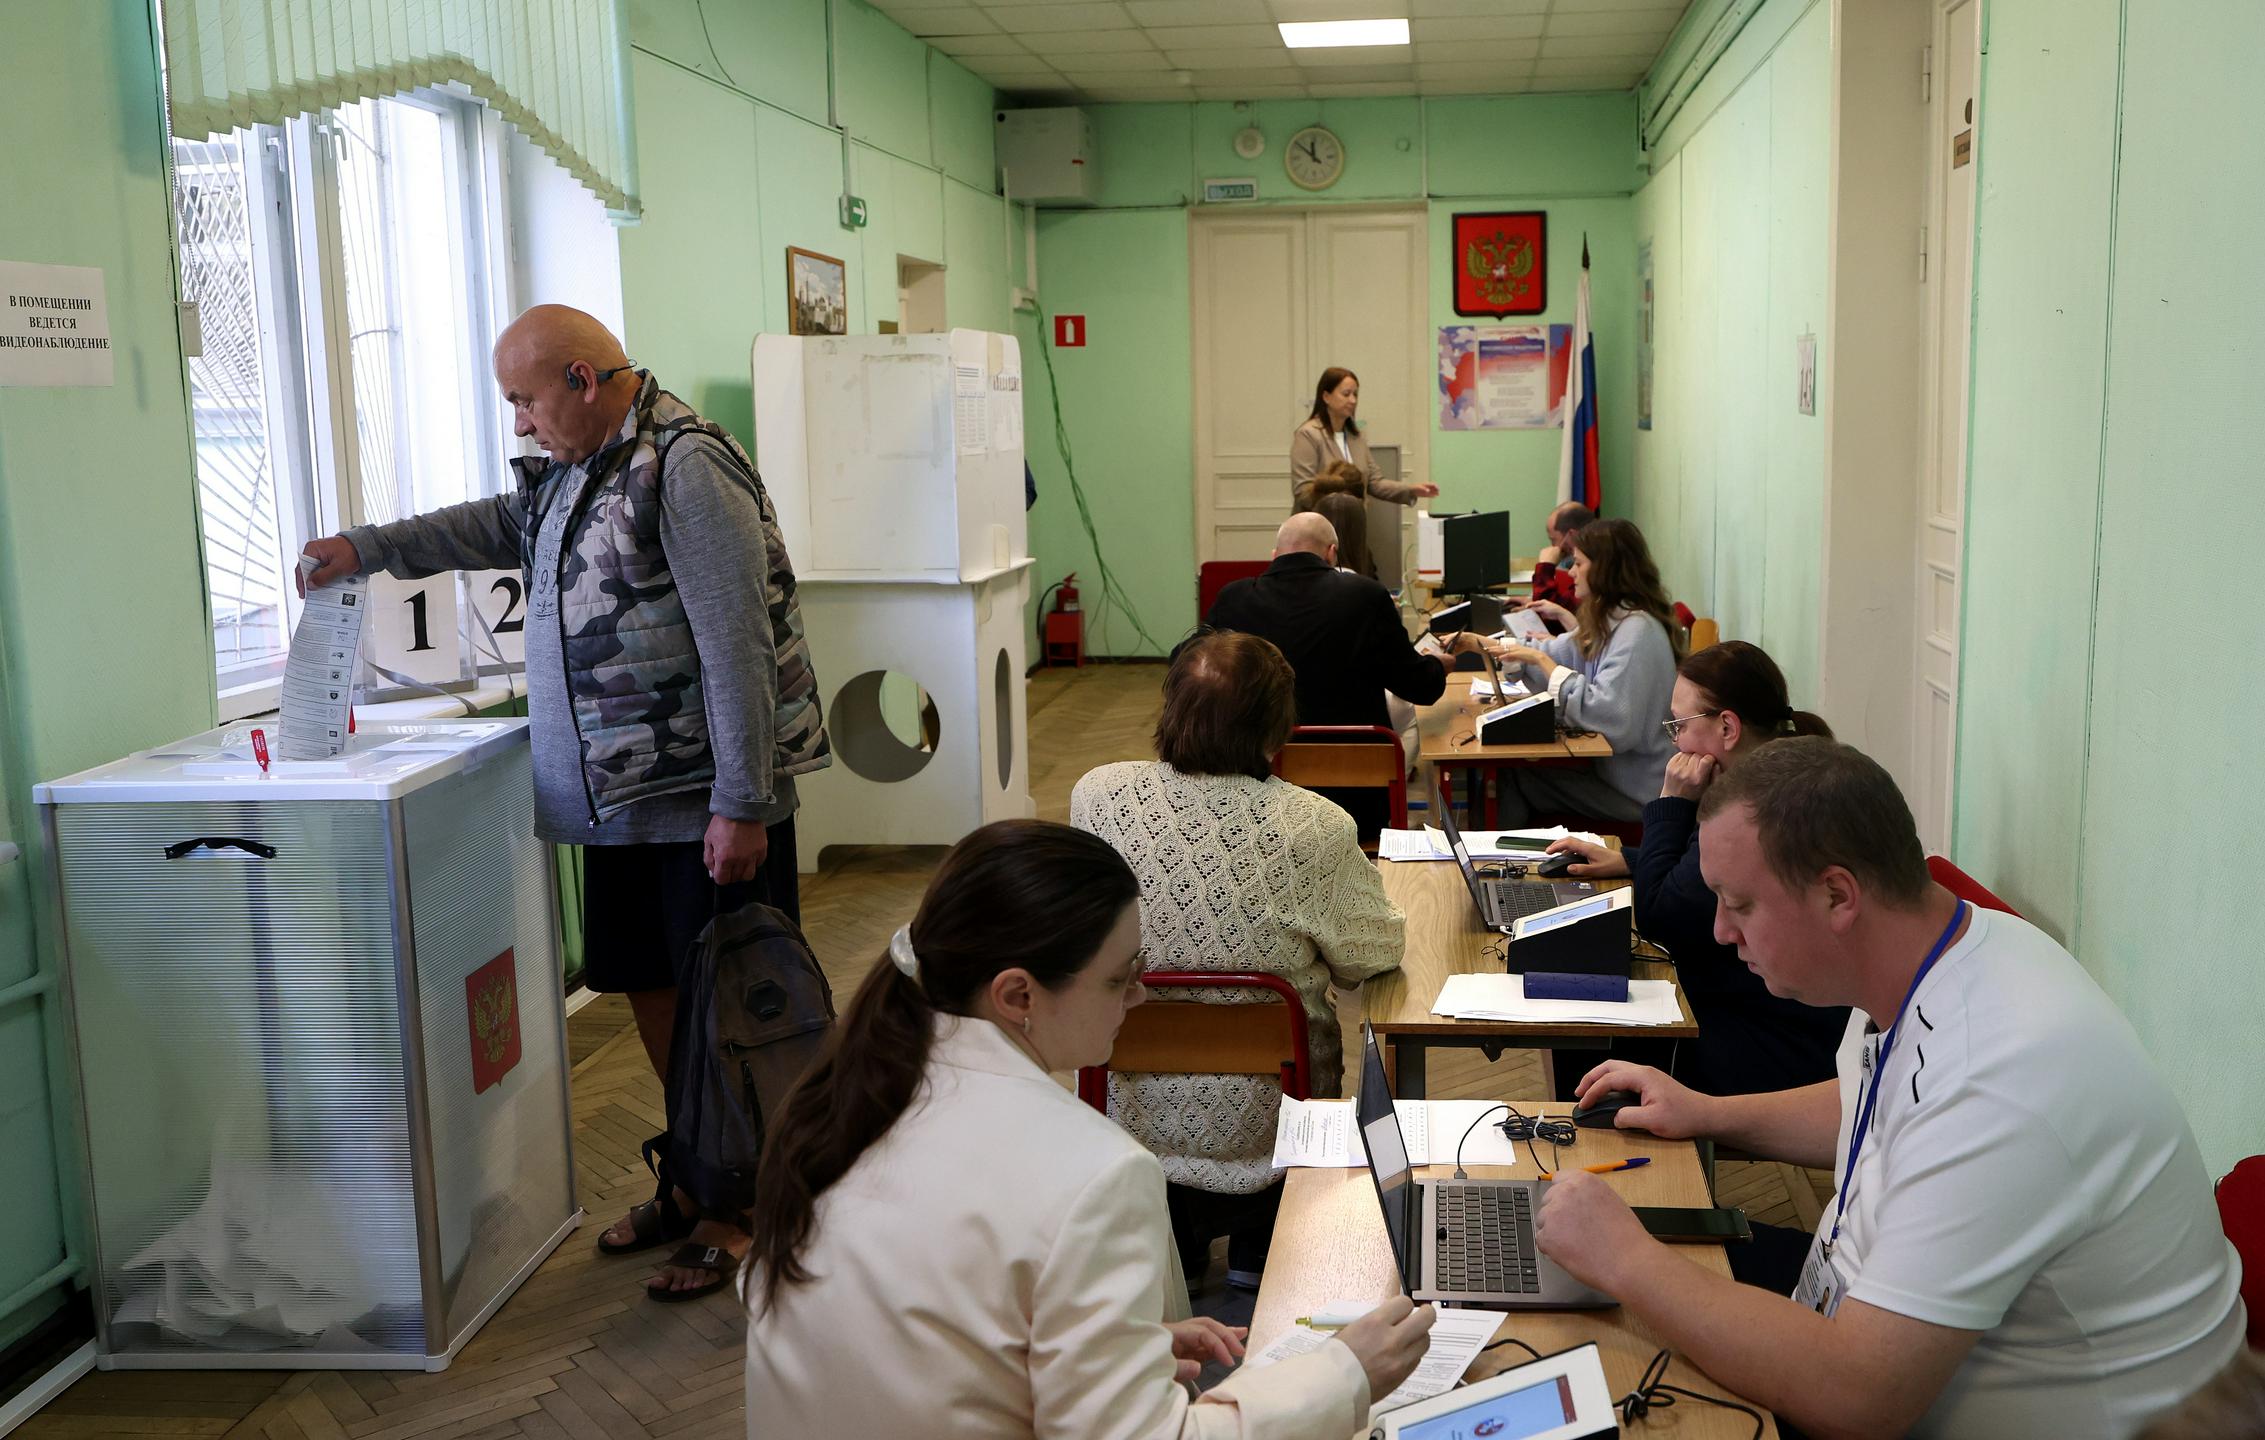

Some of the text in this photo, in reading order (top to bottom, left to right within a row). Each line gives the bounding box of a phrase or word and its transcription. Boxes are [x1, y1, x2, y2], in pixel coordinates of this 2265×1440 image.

[9, 295, 91, 310] В ПОМЕЩЕНИИ
[29, 316, 77, 330] ВЕДЕТСЯ
[0, 336, 110, 350] ВИДЕОНАБЛЮДЕНИЕ
[490, 576, 525, 634] 2
[404, 589, 436, 652] 1
